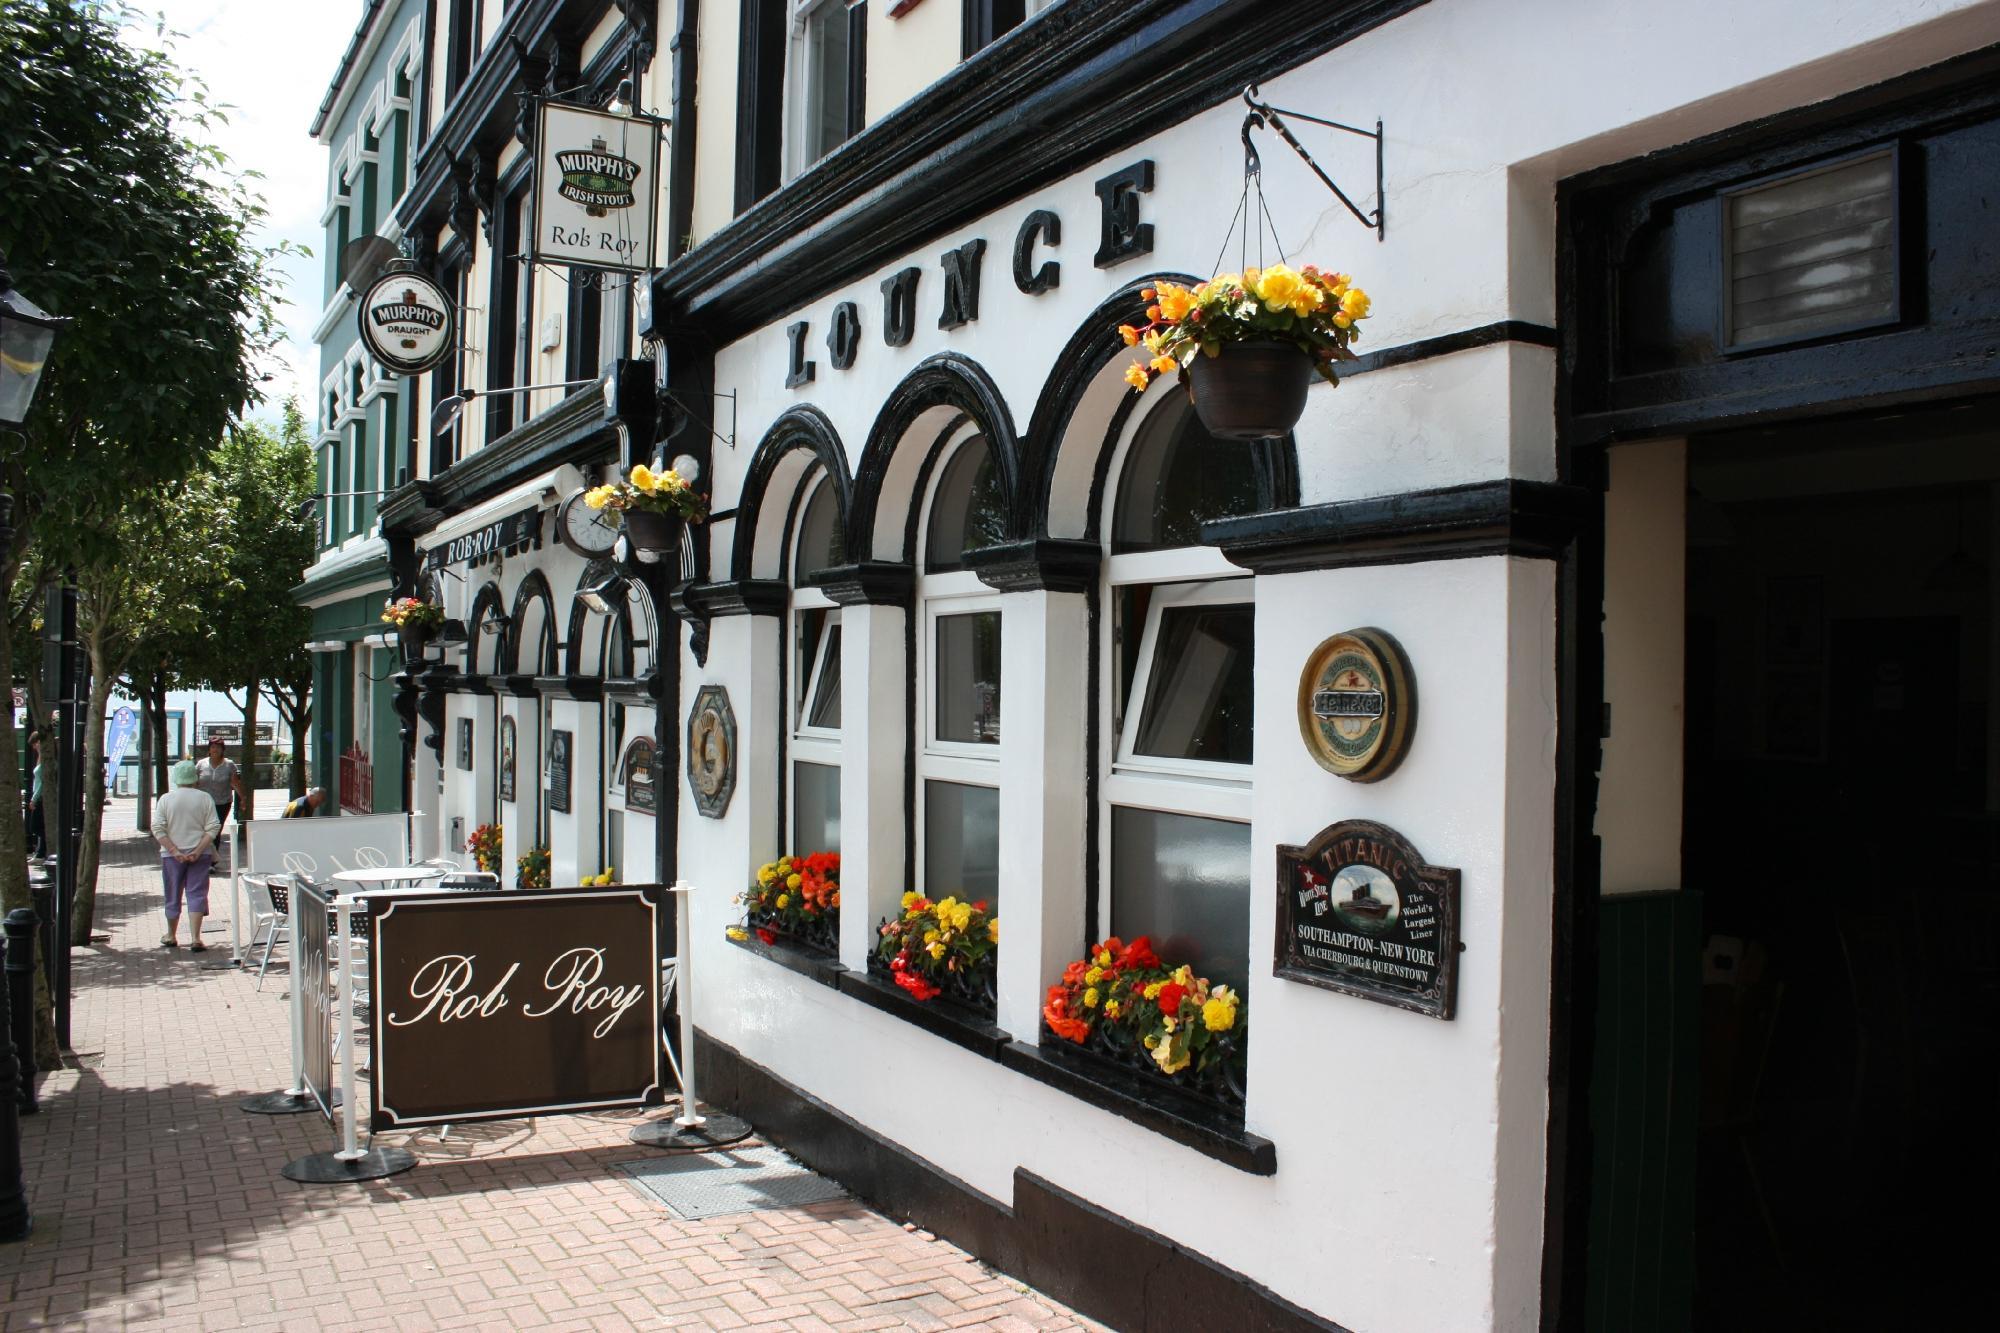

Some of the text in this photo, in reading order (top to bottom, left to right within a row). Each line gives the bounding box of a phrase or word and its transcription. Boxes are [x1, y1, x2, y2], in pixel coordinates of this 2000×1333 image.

[560, 154, 636, 181] MURPHY'S
[563, 185, 631, 206] IRISH STOUT
[551, 225, 640, 260] Rob Roy
[387, 325, 431, 336] DRAUGHT
[1321, 838, 1407, 881] TITANIC
[1407, 893, 1424, 904] The
[1402, 904, 1433, 917] World's
[1404, 916, 1436, 928] Largest
[1410, 930, 1433, 940] Liner
[1302, 944, 1316, 957] VIA
[1316, 947, 1365, 970] CHERBOURG
[1372, 959, 1429, 983] QUEENSTOWN
[1405, 945, 1436, 967] YORK
[388, 947, 645, 1039] Rob Roy
